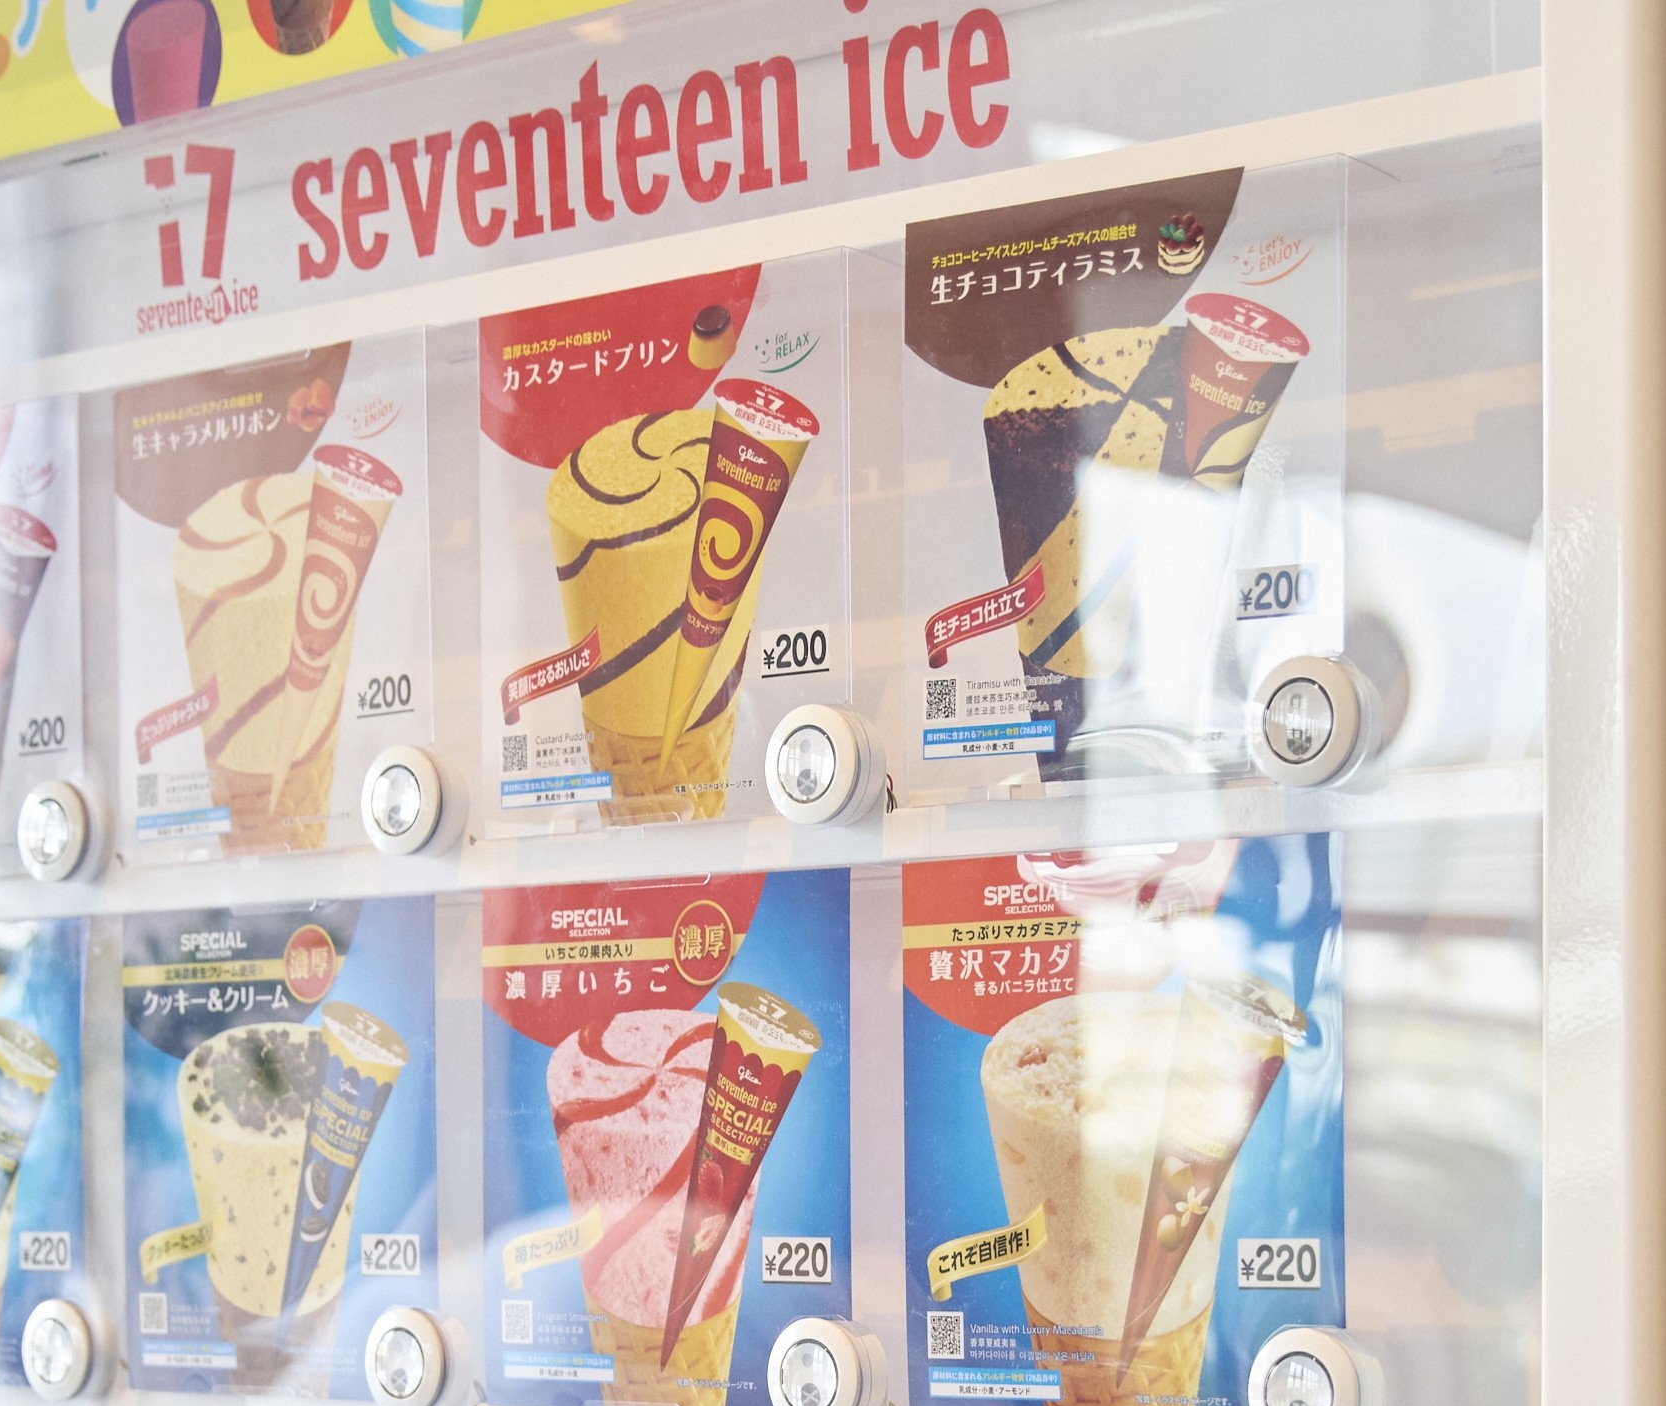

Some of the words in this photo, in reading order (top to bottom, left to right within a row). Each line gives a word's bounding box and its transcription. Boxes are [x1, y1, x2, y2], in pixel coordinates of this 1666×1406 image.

[295, 46, 810, 283] seventeen
[839, 0, 1012, 172] ice
[931, 223, 1137, 269] チョココーヒーアイスとクリームチーズアイスの組合せ
[1258, 240, 1302, 273] ENJOY
[930, 246, 1144, 305] 生チョコティラミス
[136, 286, 231, 335] seventeen
[232, 278, 259, 315] ice
[502, 329, 612, 361] 濃厚なカスタードの味わい
[774, 331, 787, 347] for
[774, 332, 812, 361] RELAX
[502, 338, 680, 393] カスタードプリン
[1215, 361, 1248, 379] Glico
[1189, 373, 1243, 411] seventeen
[1244, 394, 1267, 415] ice
[132, 408, 283, 461] 生キャラメルリボン
[738, 445, 768, 465] Glico
[716, 453, 766, 490] seventeen
[764, 473, 782, 492] ice
[1238, 569, 1314, 612] ¥200
[933, 586, 1027, 642] 生チョコ仕立て
[763, 629, 828, 671] ¥200
[507, 647, 592, 703] 笑顔になるおいしさ
[966, 680, 1001, 690] Tiramisu
[1003, 677, 1021, 687] with
[357, 673, 412, 711] ¥200
[19, 716, 66, 749] ¥200
[535, 734, 563, 745] Custard
[962, 741, 1015, 753] 乳成分・小麦・大豆
[983, 882, 1076, 907] SPECIAL
[1004, 904, 1055, 915] SELECTION
[550, 907, 628, 930] SPECIAL
[569, 928, 611, 938] SELECTION
[180, 931, 248, 951] SPECIAL
[544, 943, 634, 961] いちごの果肉入り
[678, 922, 726, 961] 濃厚
[289, 948, 330, 980] 濃厚
[505, 964, 670, 1000] 濃厚いちご
[973, 977, 1074, 997] 香るバニラ仕立て
[142, 985, 289, 1016] クッキー&クリーム
[737, 1065, 762, 1086] Glico
[716, 1072, 759, 1110] seventeen
[761, 1095, 778, 1114] ice
[313, 1097, 369, 1142] SPECIAL
[706, 1087, 774, 1137] SPECIAL
[710, 1113, 761, 1147] SELECTION
[22, 1236, 68, 1265] ¥220
[363, 1238, 418, 1271] ¥220
[514, 1227, 581, 1265] 苺たっぷり
[764, 1241, 829, 1279] ¥220
[938, 1227, 1031, 1275] これぞ自信作!
[1241, 1243, 1317, 1283] ¥220
[970, 1324, 999, 1335] Vanilla
[1001, 1324, 1020, 1335] with
[1022, 1325, 1051, 1338] Luxury
[959, 1385, 1032, 1397] 乳成分・小麦・アーモンド
